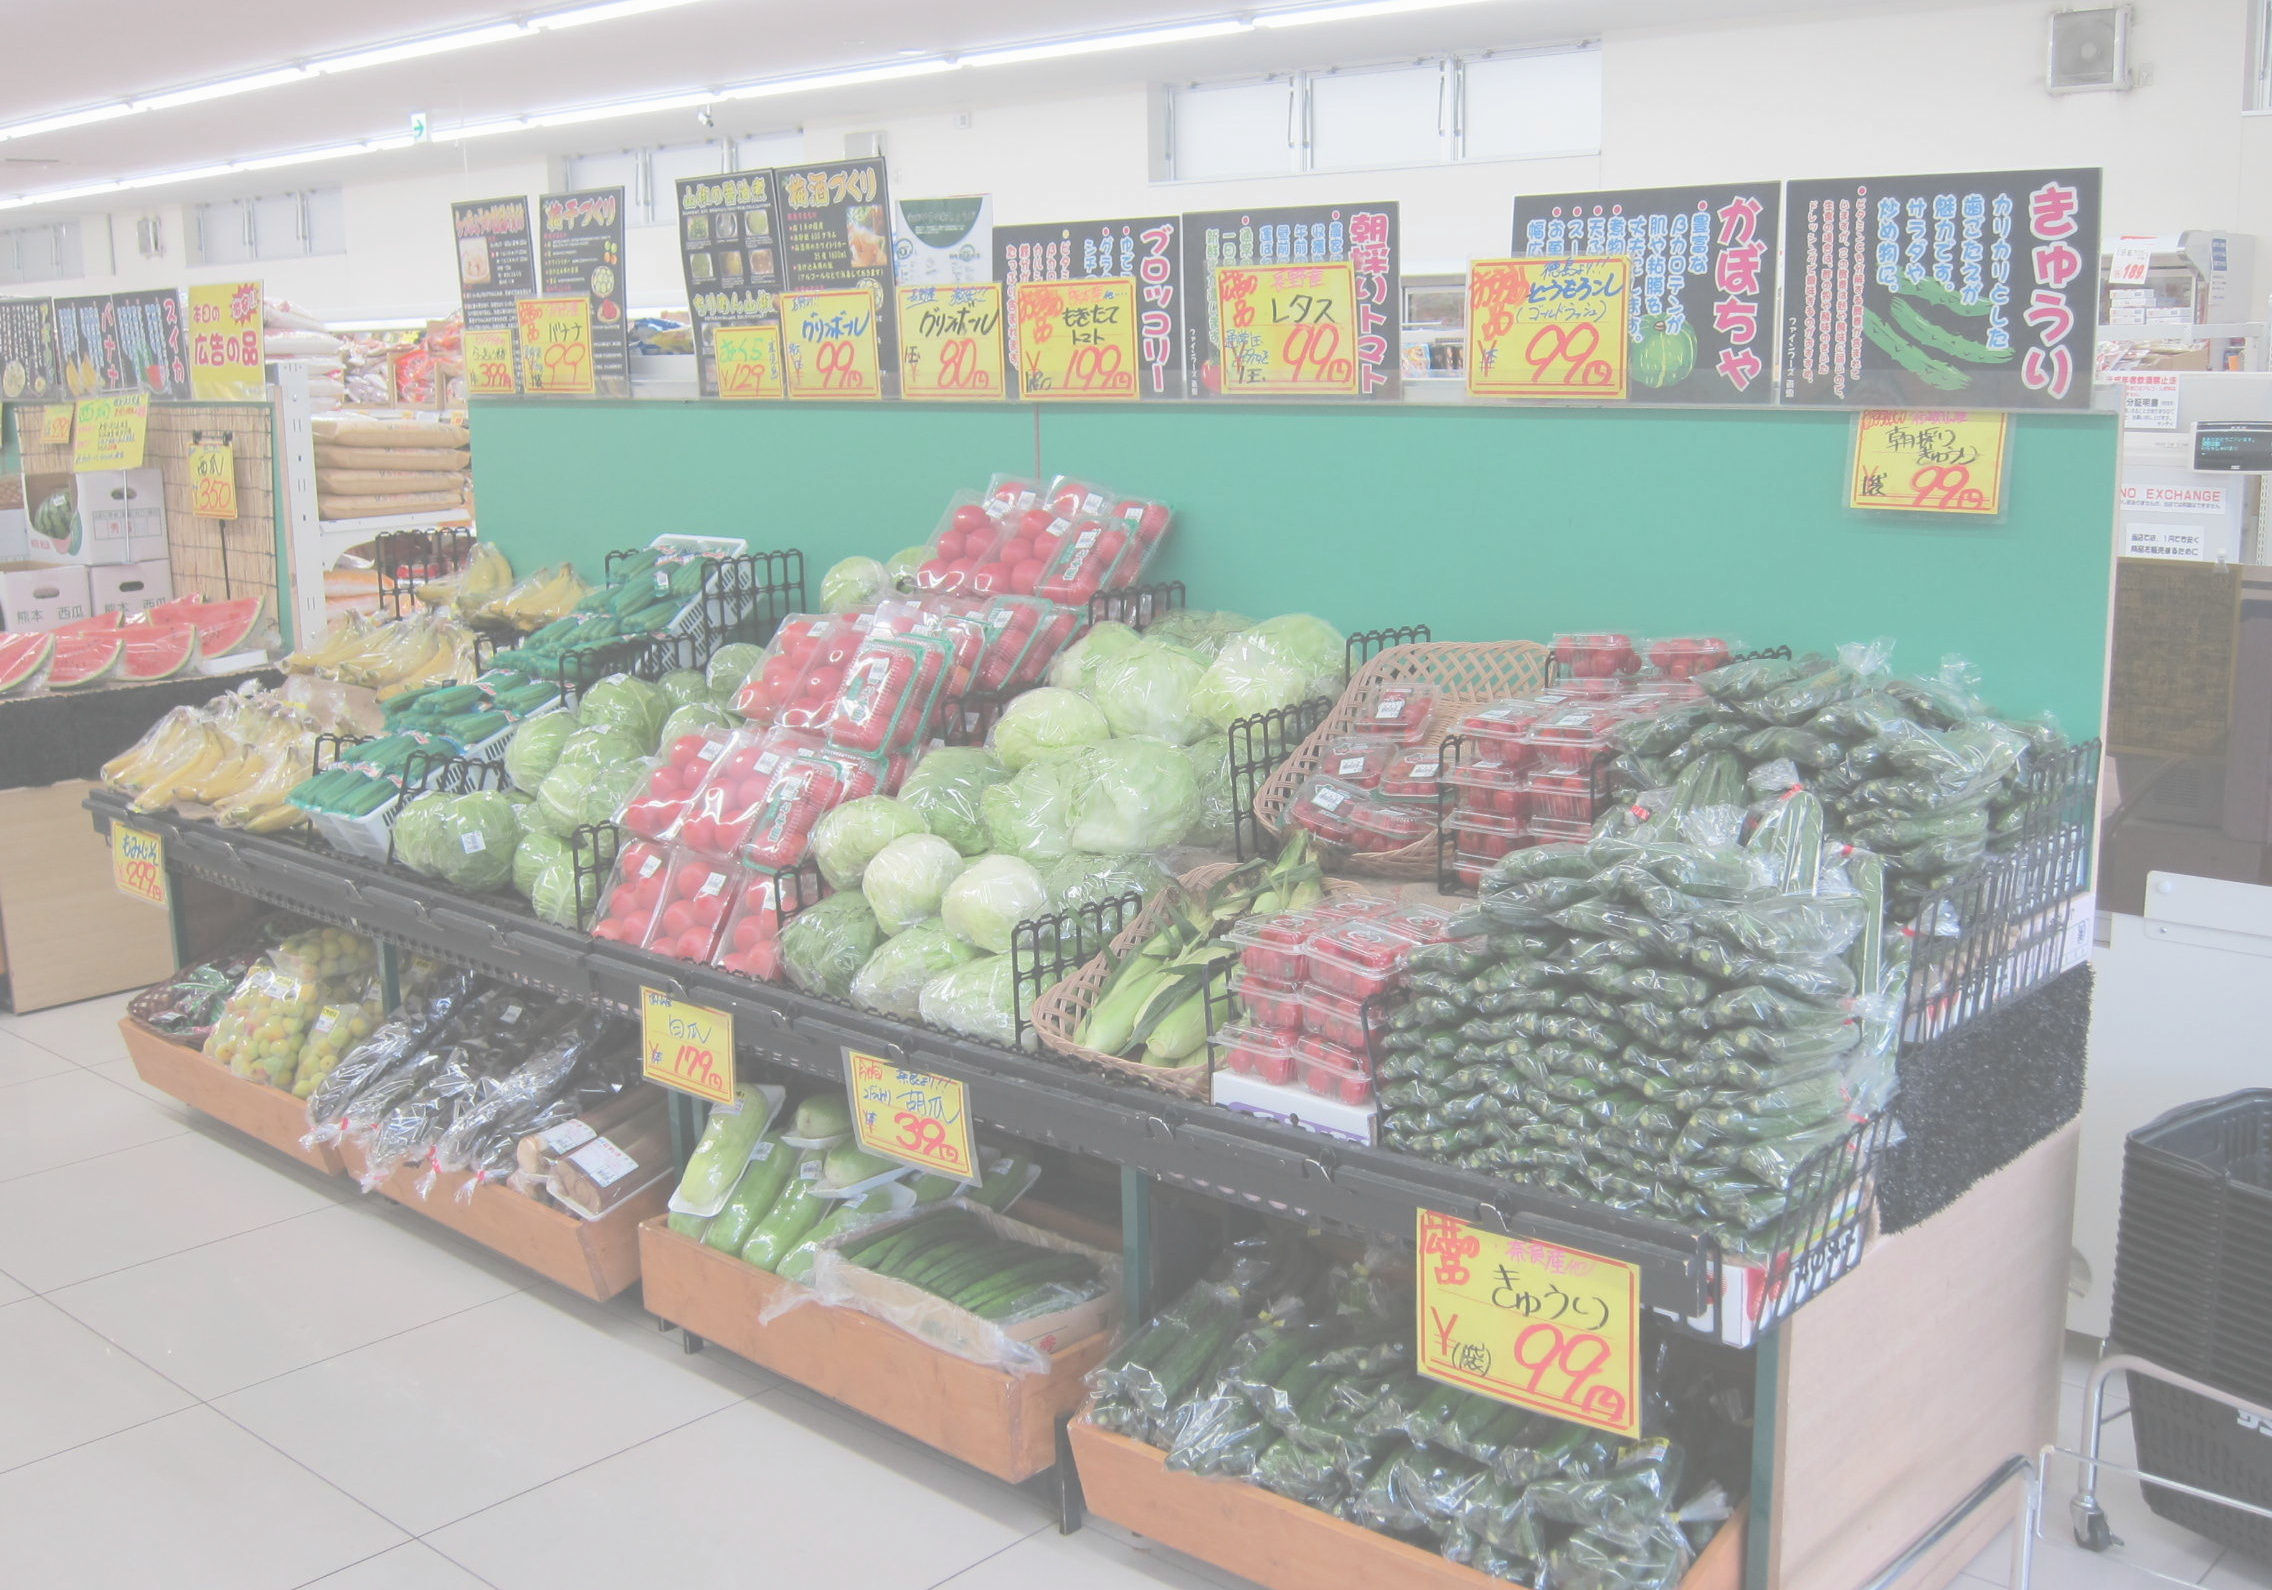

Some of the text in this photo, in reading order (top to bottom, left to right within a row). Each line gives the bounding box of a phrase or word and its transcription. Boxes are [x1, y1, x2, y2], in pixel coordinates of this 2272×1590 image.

[1904, 197, 1926, 284] サラダや
[1961, 193, 1984, 306] 歯ごたえが
[1528, 273, 1624, 303] とうもろこし
[2022, 181, 2081, 399] きゅうり
[1140, 223, 1178, 393] ブロッコリー
[1272, 294, 1335, 323] レタス
[195, 330, 259, 367] 広告の品
[549, 322, 582, 342] バナナ
[1072, 328, 1104, 345] トマト
[2120, 487, 2221, 502] NO EXCHANGE
[16, 605, 83, 623] 熊本 西瓜
[1492, 1264, 1609, 1330] きゅうり
